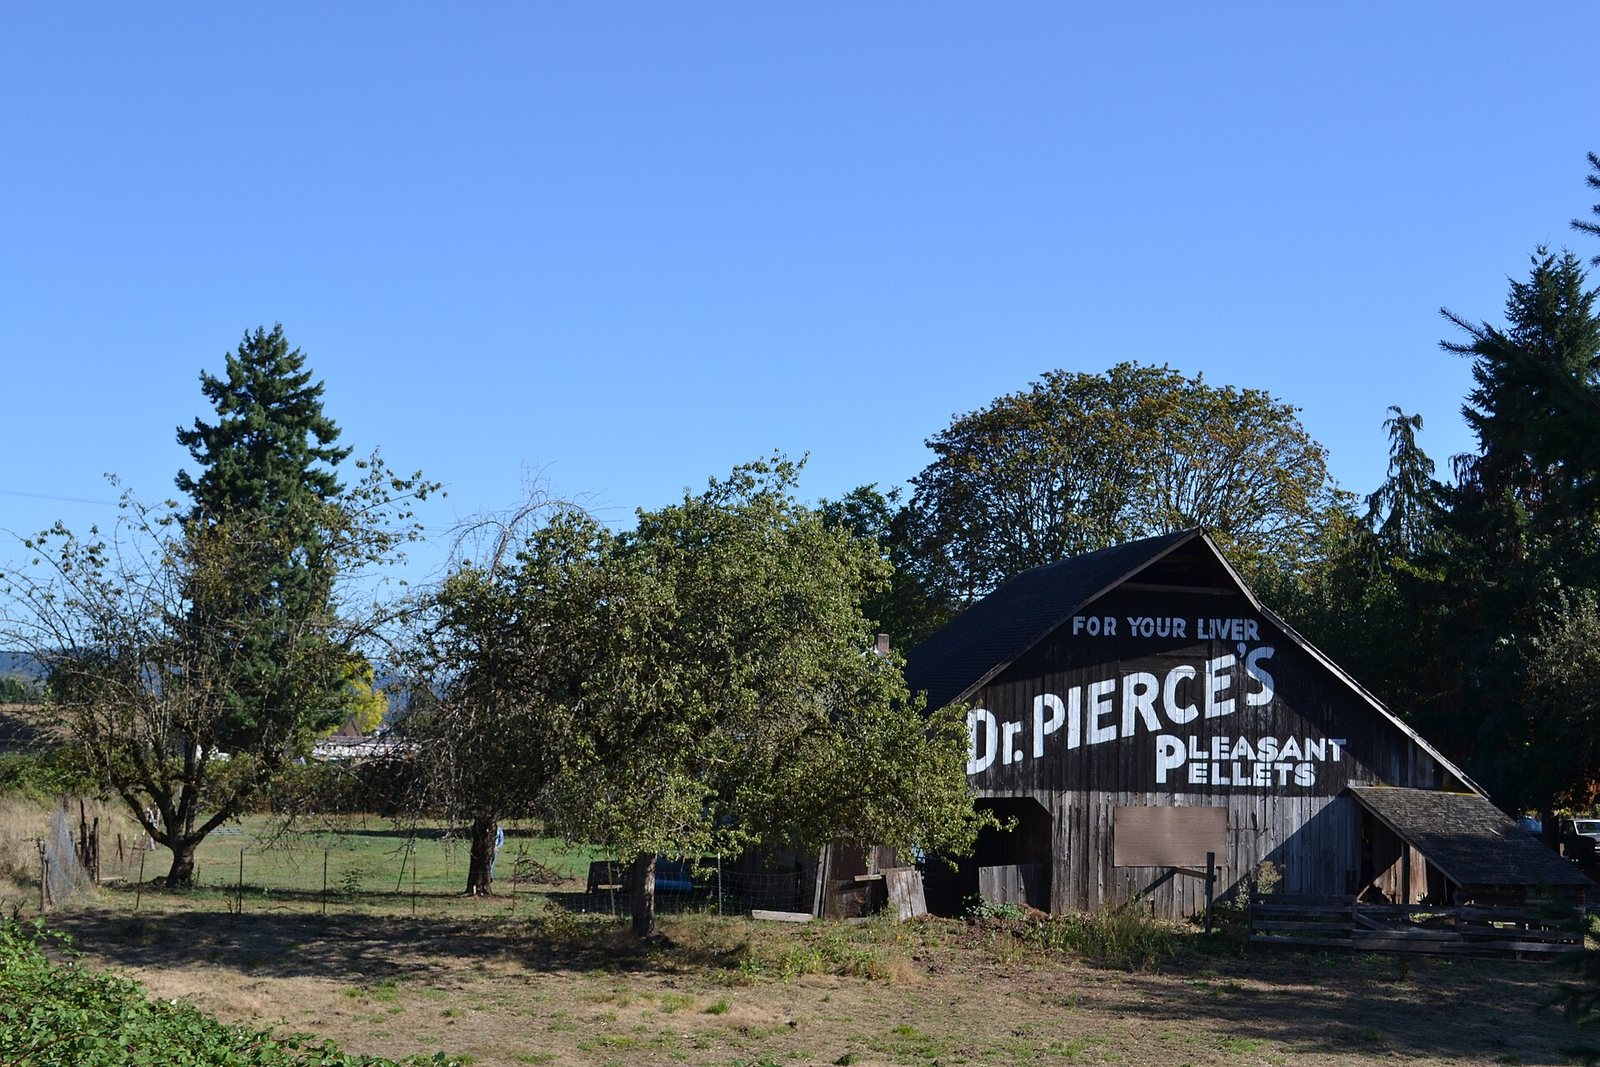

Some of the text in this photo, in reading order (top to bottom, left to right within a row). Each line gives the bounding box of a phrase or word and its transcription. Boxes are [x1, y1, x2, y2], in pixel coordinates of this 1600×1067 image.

[1073, 616, 1260, 641] FOR YOUR LIVER
[1033, 642, 1275, 758] PIERCE'S
[1155, 734, 1347, 784] PLEASANT
